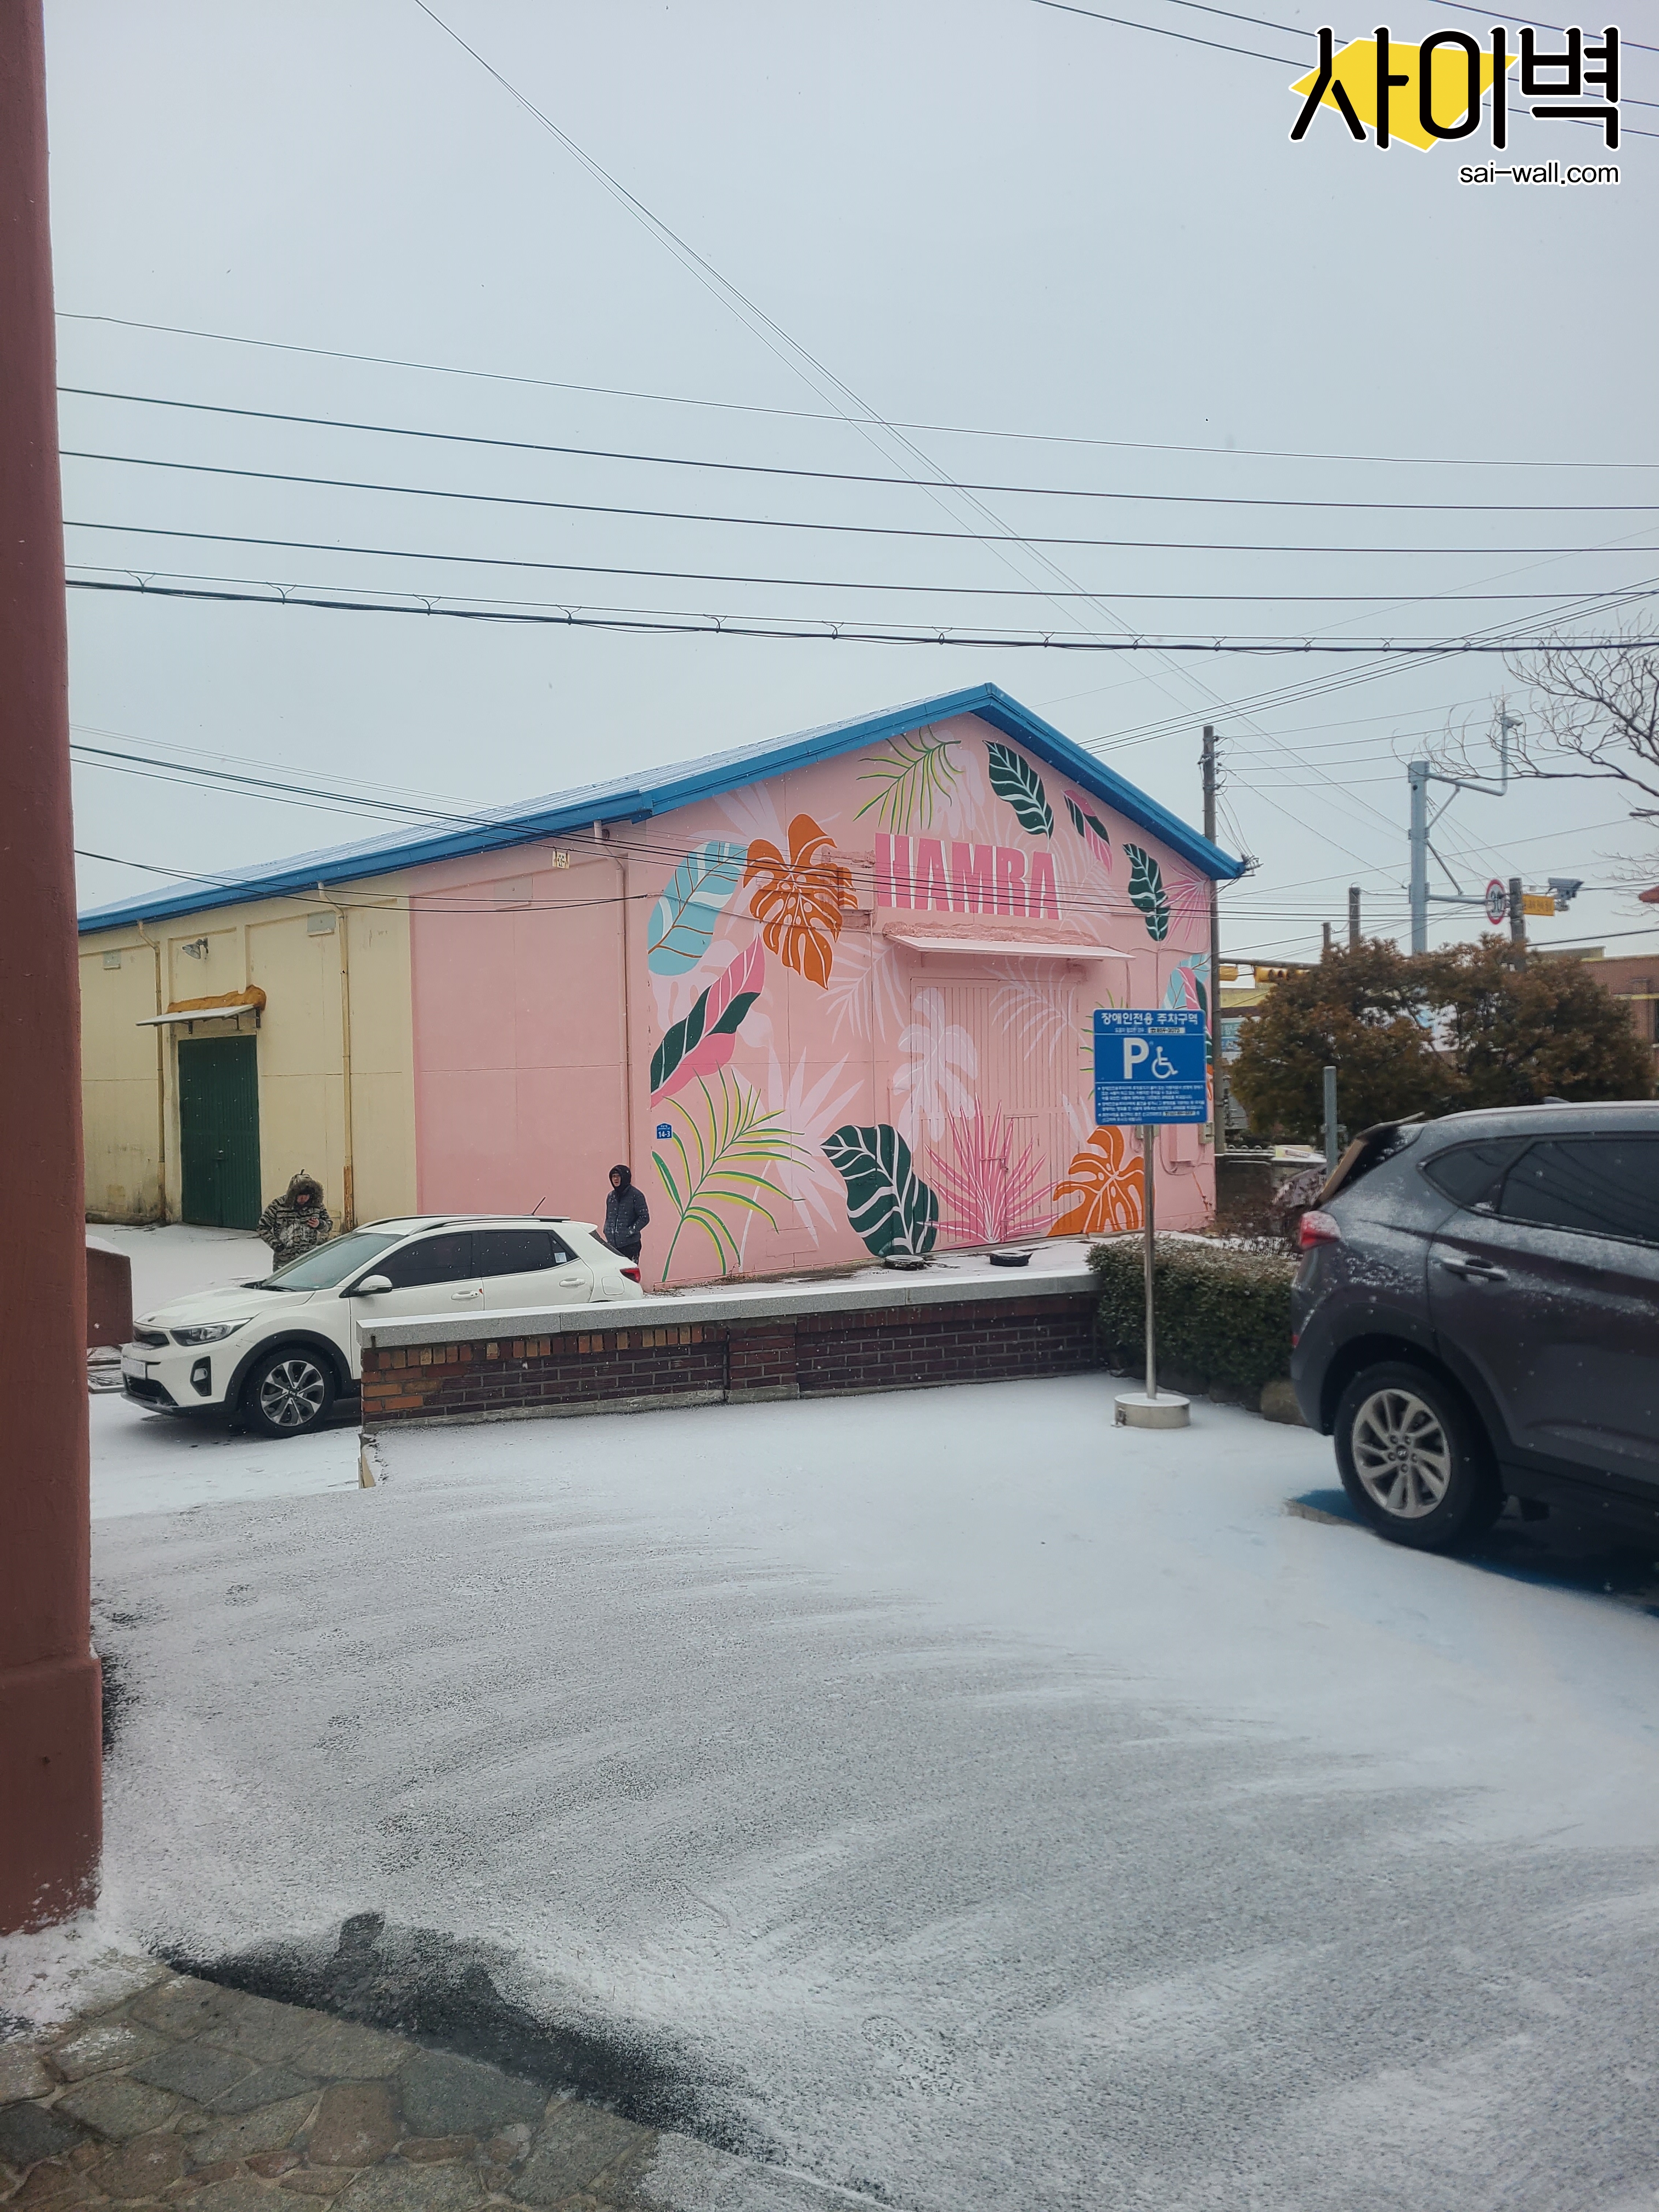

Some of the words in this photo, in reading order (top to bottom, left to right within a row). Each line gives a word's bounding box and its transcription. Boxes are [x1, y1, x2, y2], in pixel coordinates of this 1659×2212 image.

[1101, 1013, 1154, 1025] 장애인전용
[1156, 1013, 1198, 1025] 주차구역
[1123, 1037, 1149, 1079] P
